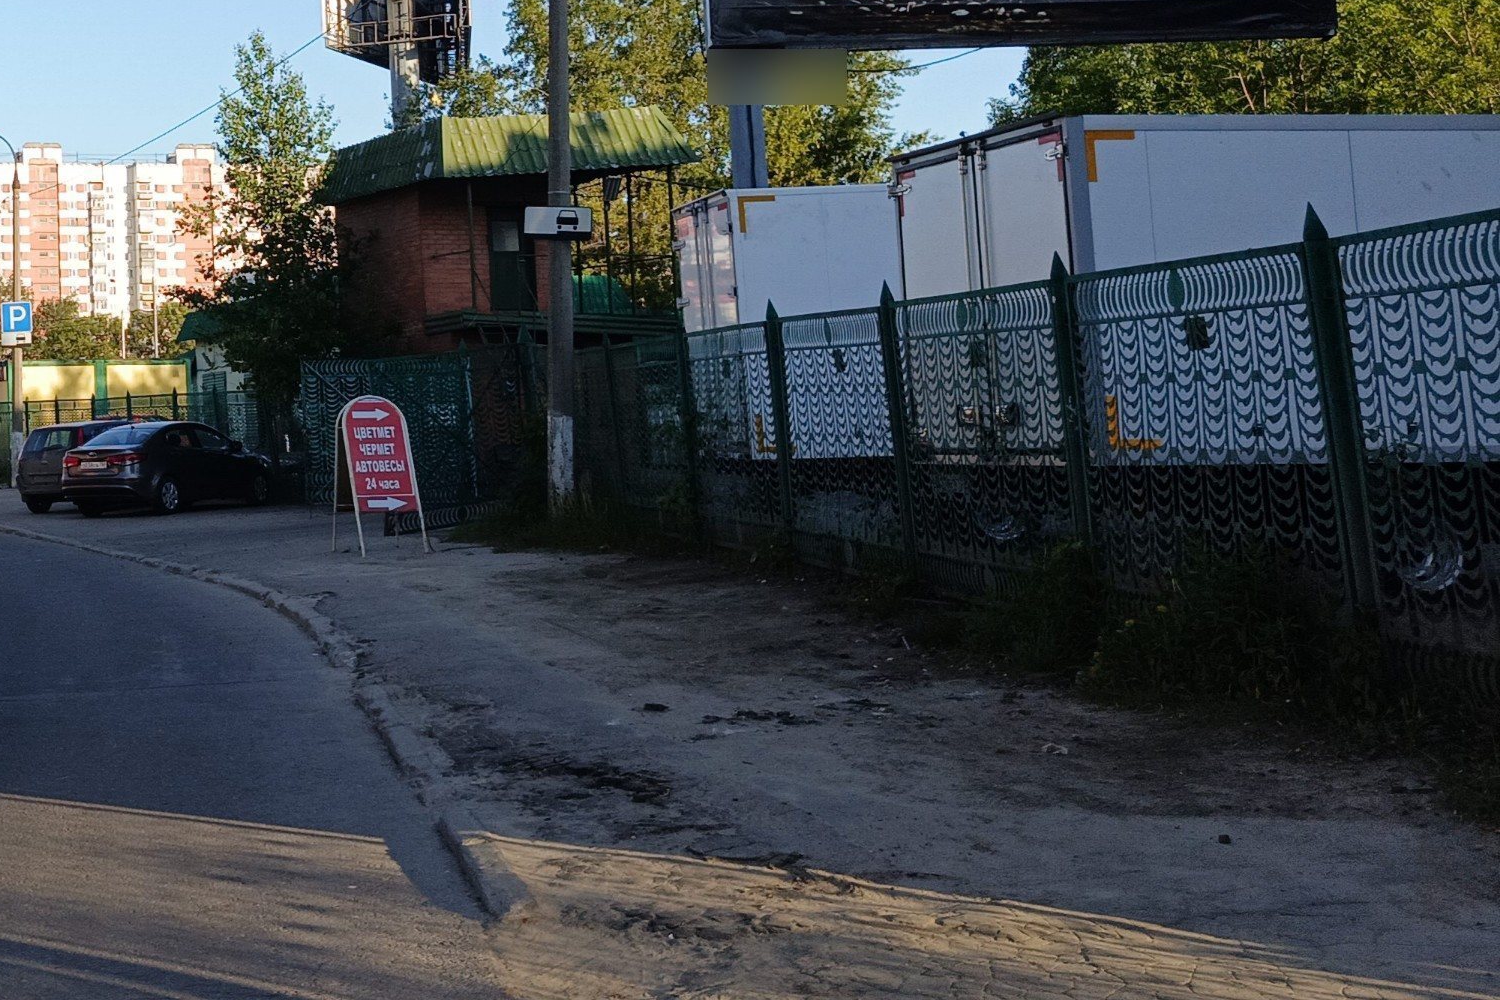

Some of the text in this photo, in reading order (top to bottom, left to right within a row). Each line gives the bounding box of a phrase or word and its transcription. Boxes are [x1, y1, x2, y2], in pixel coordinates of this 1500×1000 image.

[10, 305, 27, 330] P
[353, 426, 395, 441] ЦВЕТМЕТ
[359, 443, 395, 456] ЧЕРМЕТ
[355, 460, 405, 473] АВТОВЕСЫ
[365, 478, 401, 490] 24 часа
